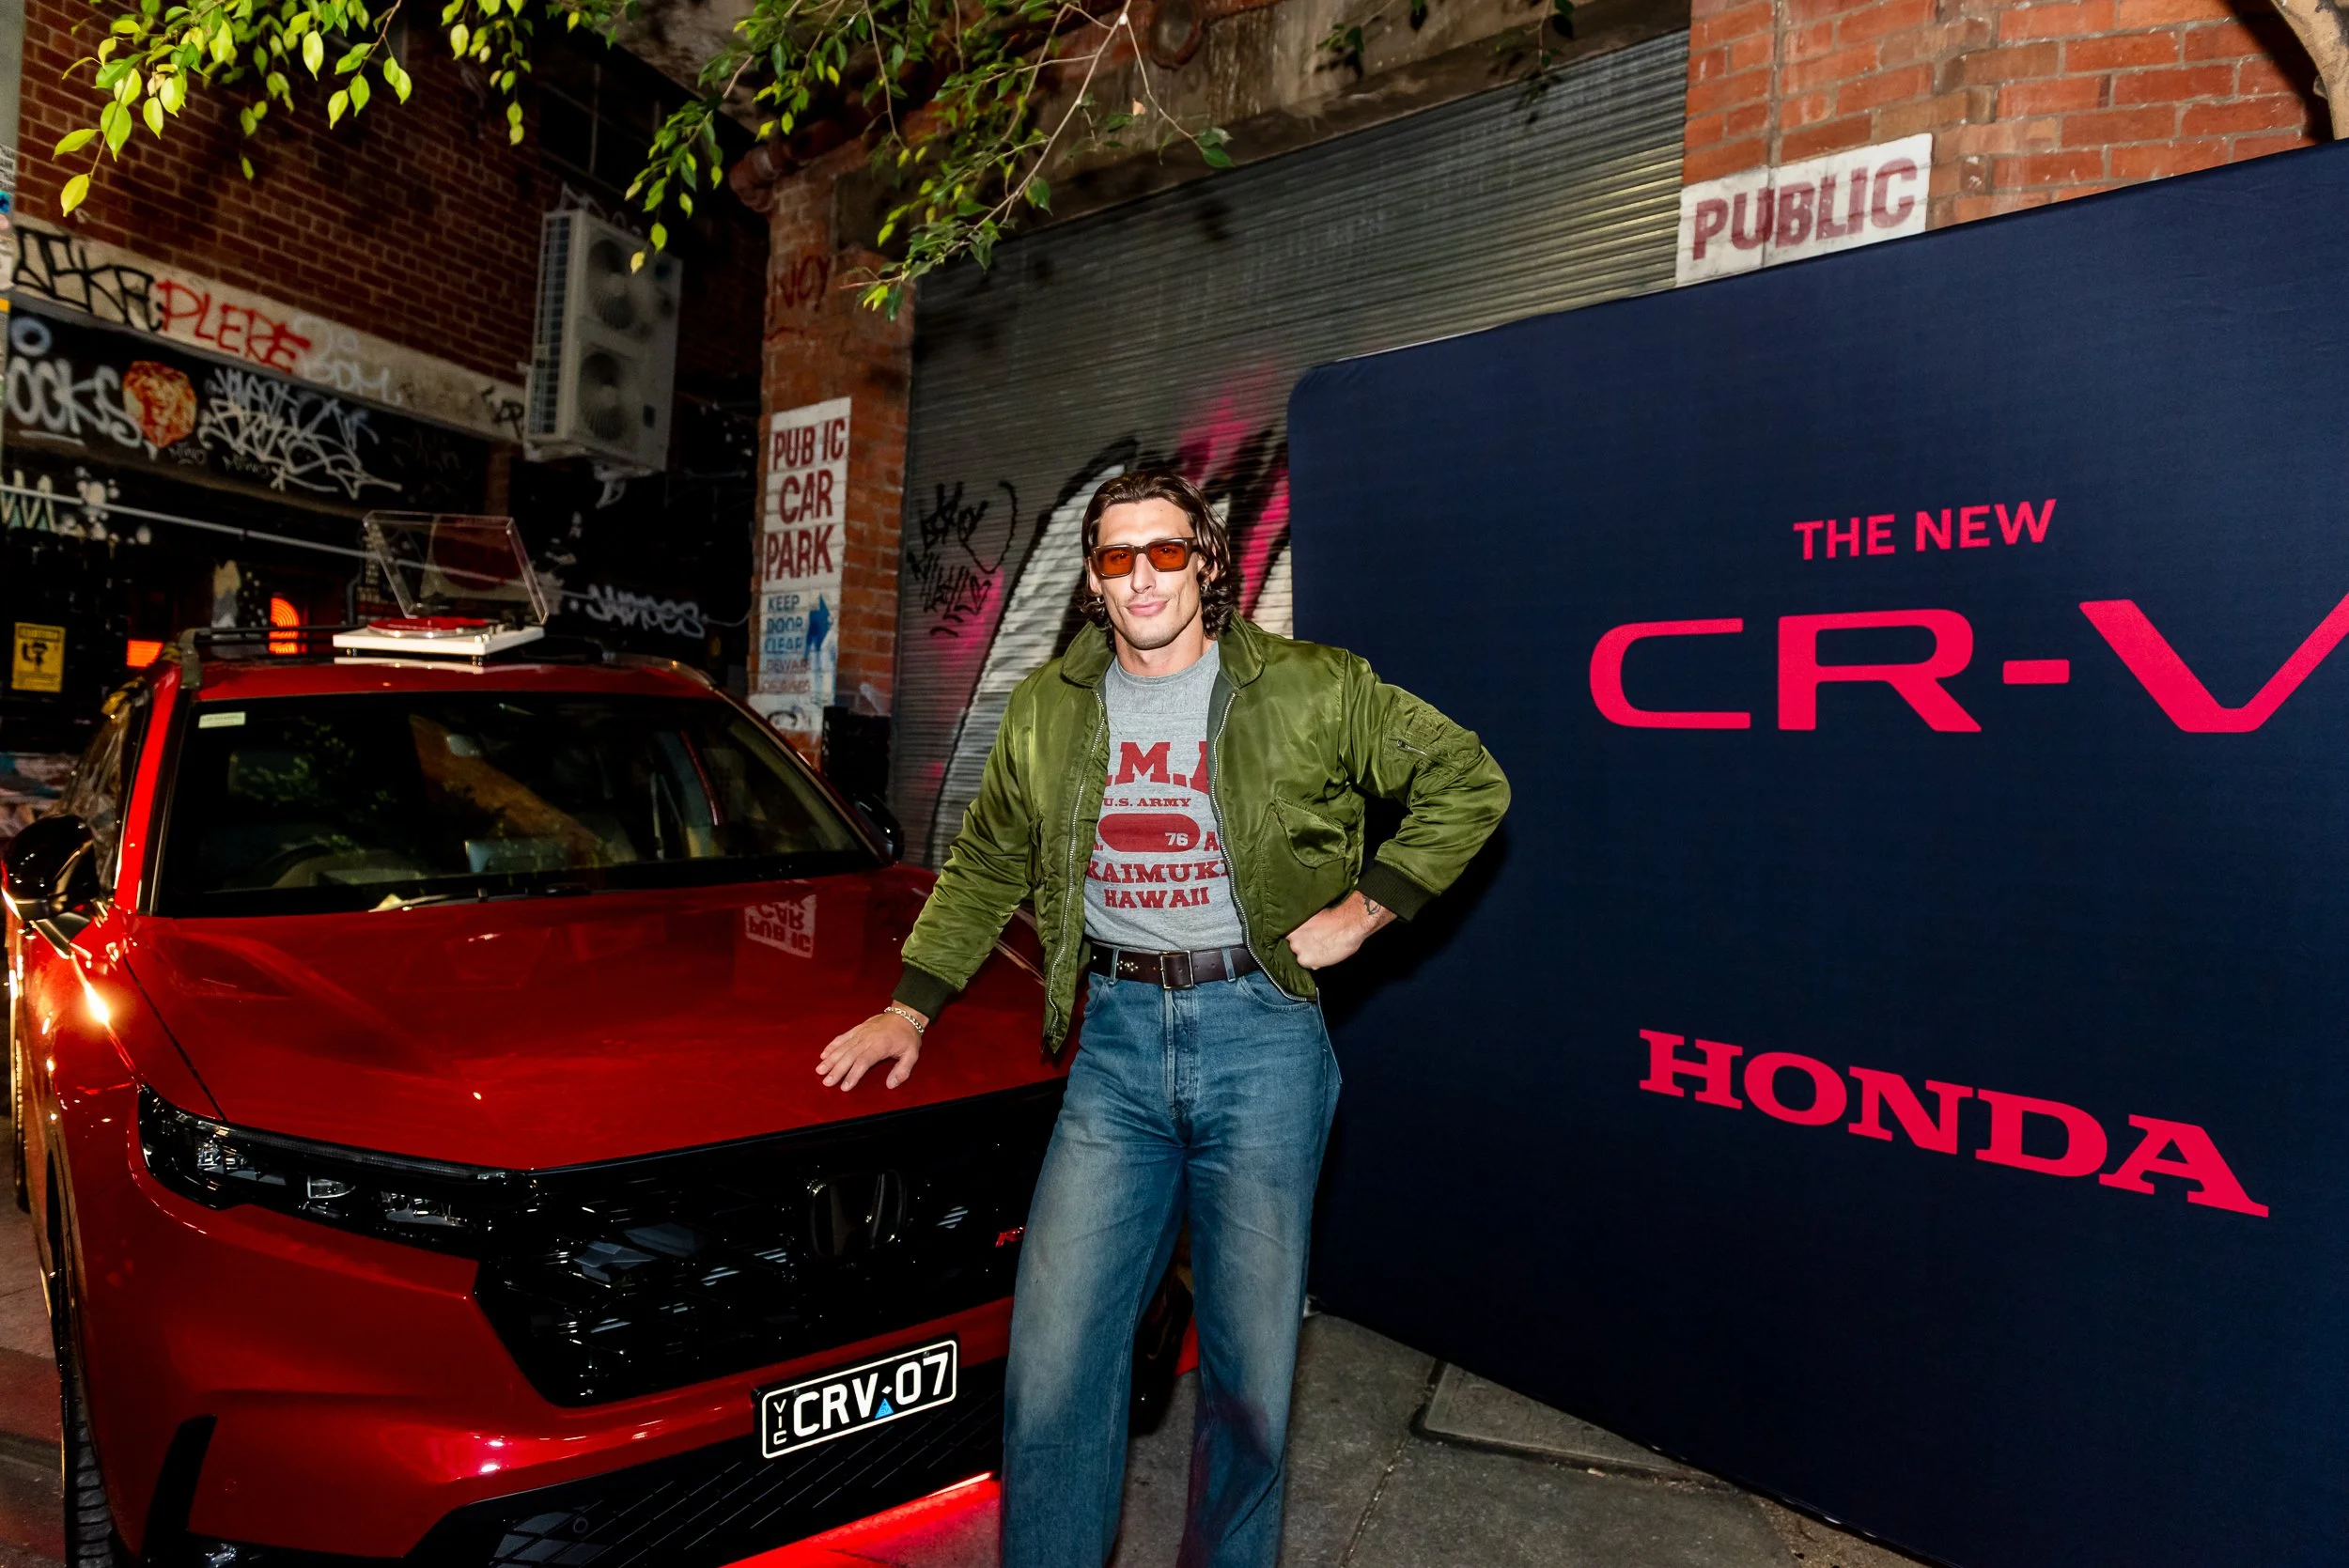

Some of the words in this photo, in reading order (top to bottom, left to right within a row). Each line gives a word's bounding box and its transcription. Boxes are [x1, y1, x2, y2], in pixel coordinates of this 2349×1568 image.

[1692, 158, 1918, 260] PUBLIC
[774, 418, 845, 471] PUBIC
[780, 469, 833, 524] CAR
[765, 523, 833, 582] PARK
[1793, 513, 1896, 561] THE
[1915, 498, 2057, 552] NEW
[767, 594, 800, 611] KEEP
[1589, 595, 2349, 734] CR-V
[1103, 798, 1133, 807] U.S.
[1137, 798, 1191, 807] ARMY
[1165, 832, 1189, 846] 76
[1104, 886, 1210, 908] HAWAII
[1639, 1029, 2269, 1219] HONDA
[773, 1398, 787, 1445] VIC
